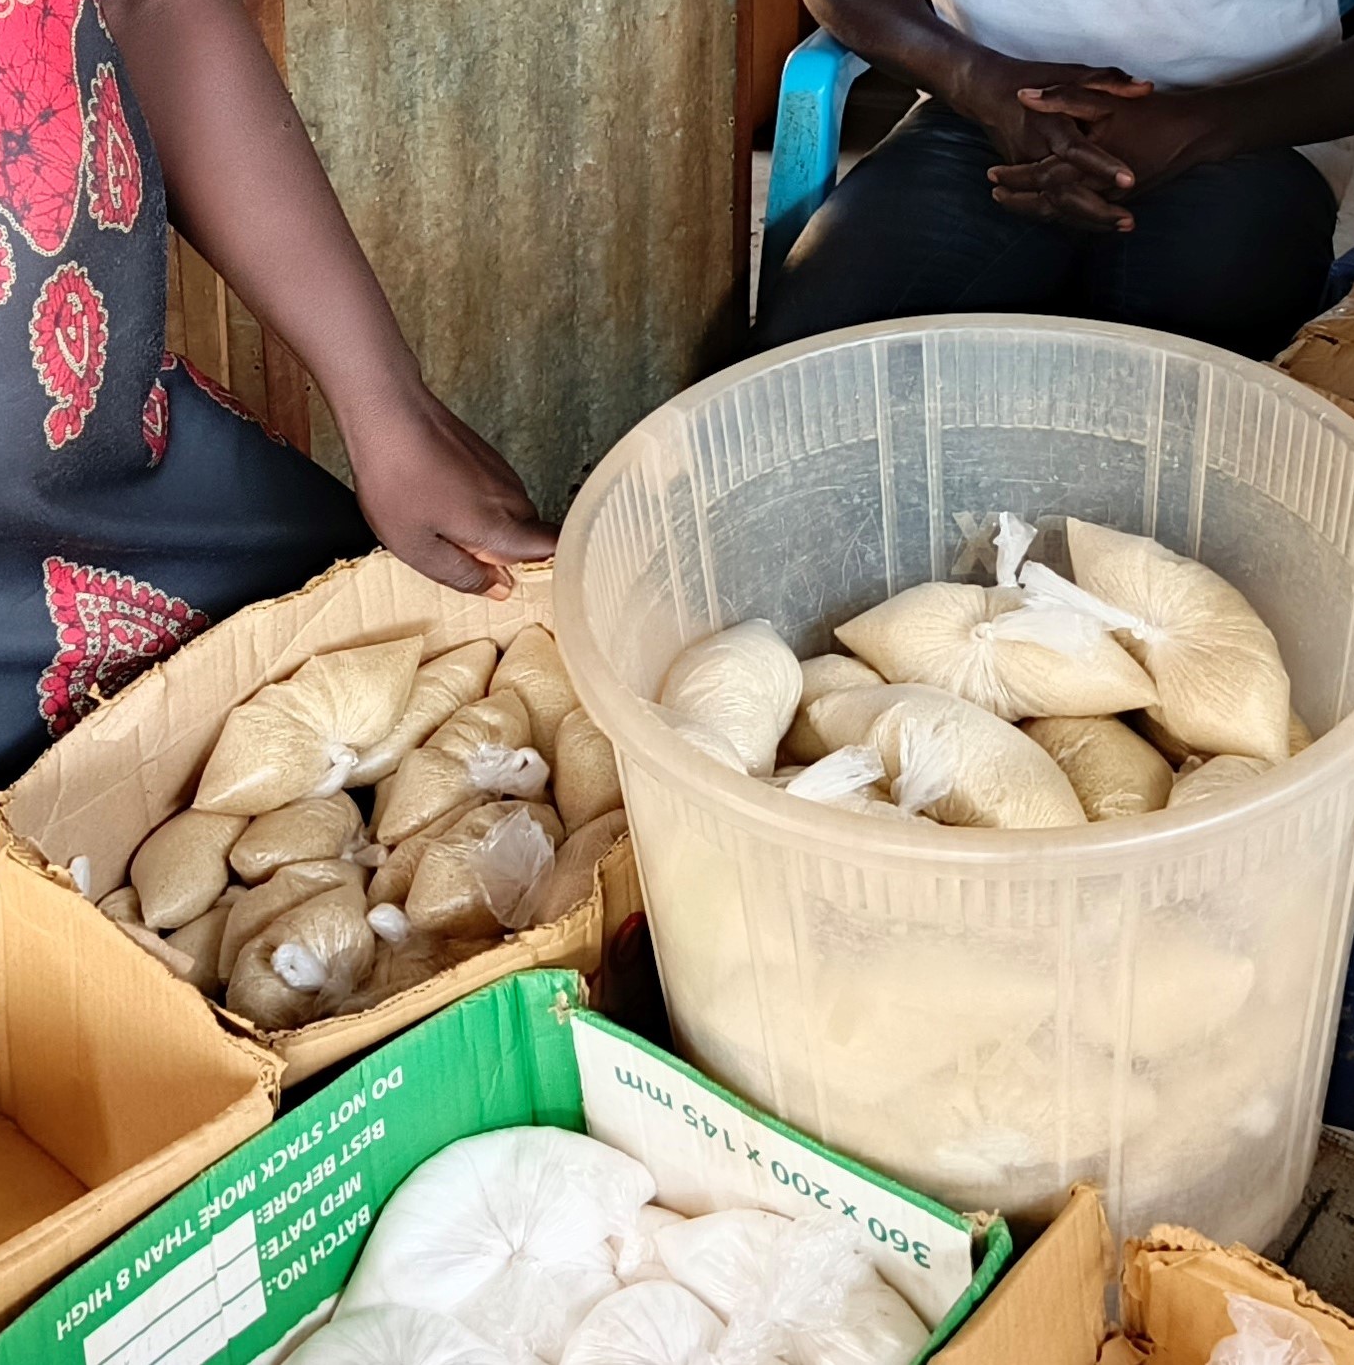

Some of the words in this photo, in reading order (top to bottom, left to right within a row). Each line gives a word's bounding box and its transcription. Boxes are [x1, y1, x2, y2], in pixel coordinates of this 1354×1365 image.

[372, 1065, 404, 1100] DO
[615, 1066, 673, 1110] mm
[327, 1088, 367, 1134] NOT
[682, 1105, 736, 1152] 145
[262, 1122, 323, 1183] STACK
[340, 1118, 385, 1166] BEST
[745, 1141, 763, 1167] x
[199, 1170, 256, 1229] MORE
[257, 1153, 335, 1225] BEFORE:
[321, 1172, 362, 1216] MFD
[771, 1161, 832, 1209] 200
[311, 1204, 372, 1258] BATCH
[840, 1197, 860, 1223] x
[135, 1219, 196, 1278] THAN
[261, 1210, 317, 1260] DATE:
[868, 1217, 931, 1269] 360
[117, 1268, 131, 1290] 8
[56, 1284, 113, 1340] HIGH
